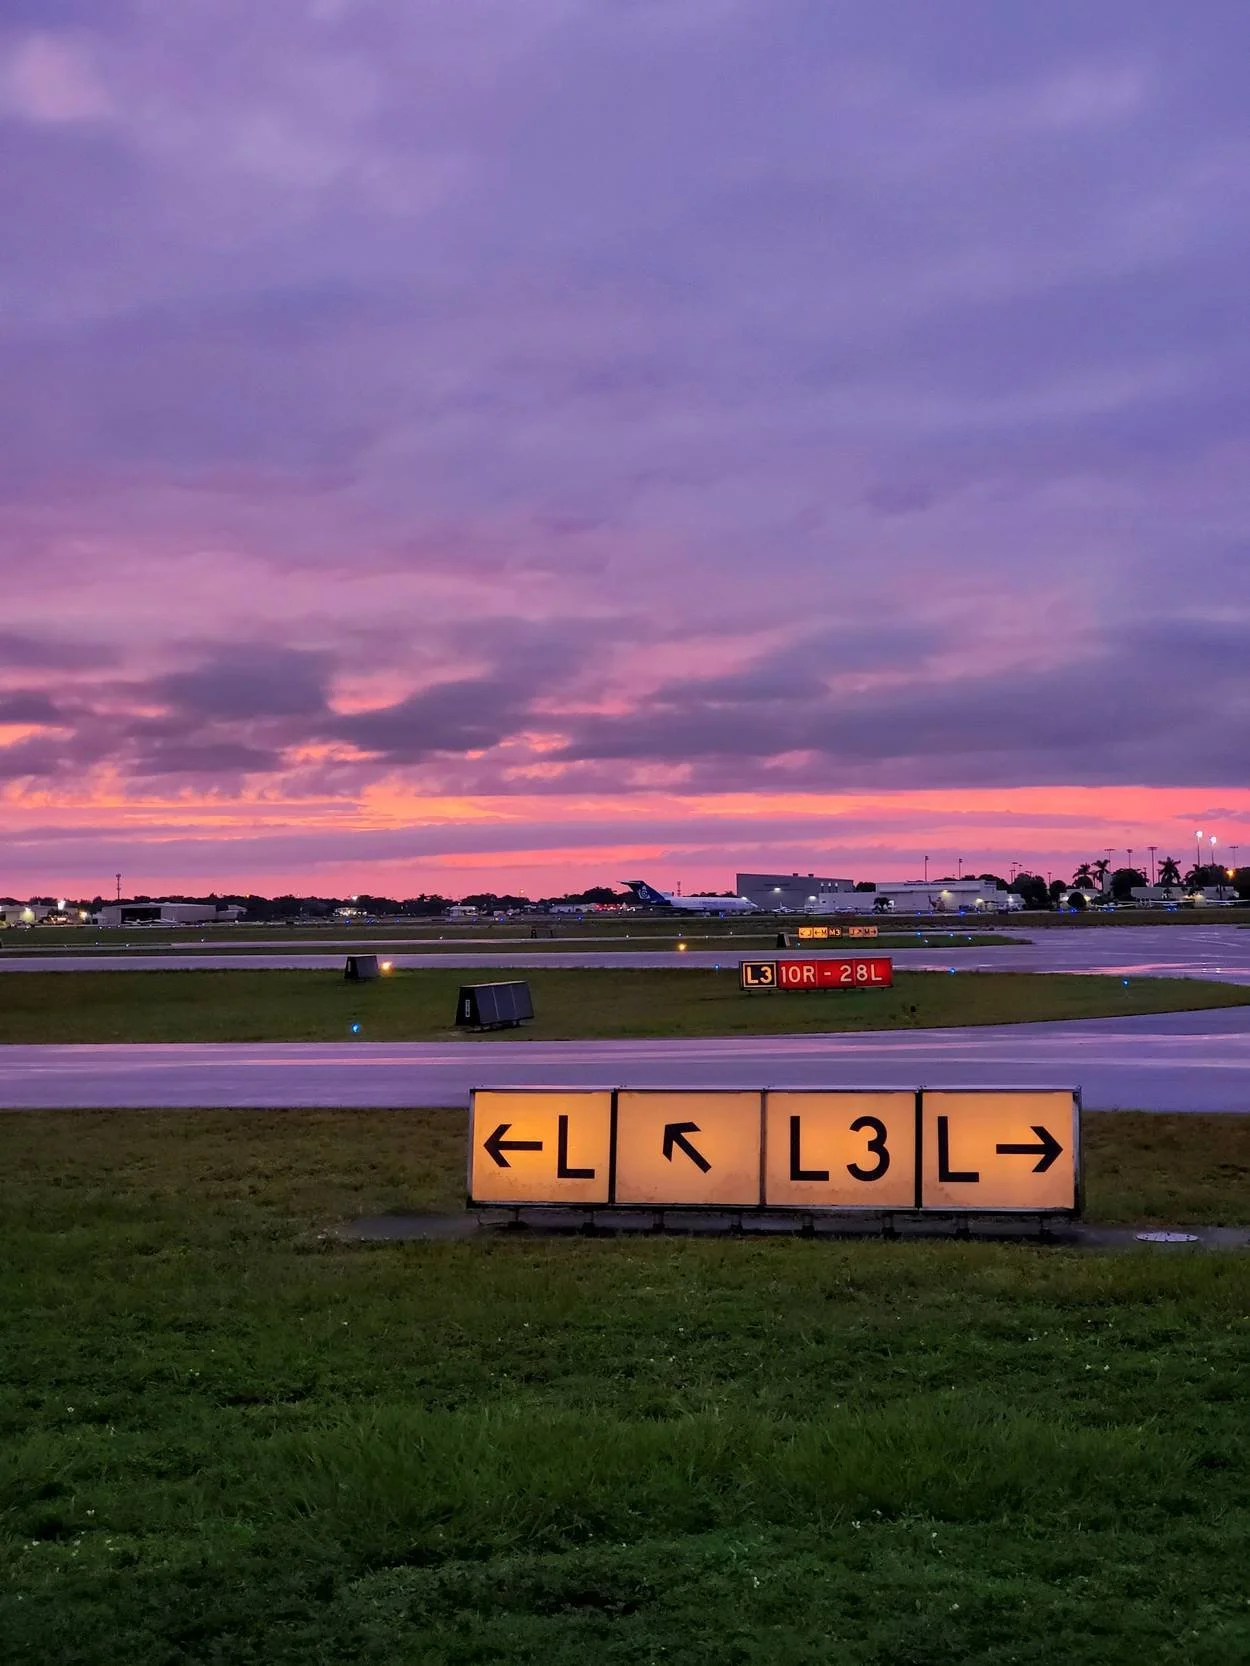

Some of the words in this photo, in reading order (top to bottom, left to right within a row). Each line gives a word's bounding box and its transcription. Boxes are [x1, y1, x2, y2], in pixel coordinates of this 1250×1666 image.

[829, 928, 841, 936] M3
[746, 966, 773, 984] L3
[780, 965, 815, 983] 10R
[840, 963, 882, 982] 28L
[557, 1115, 595, 1179] L
[938, 1116, 980, 1182] L
